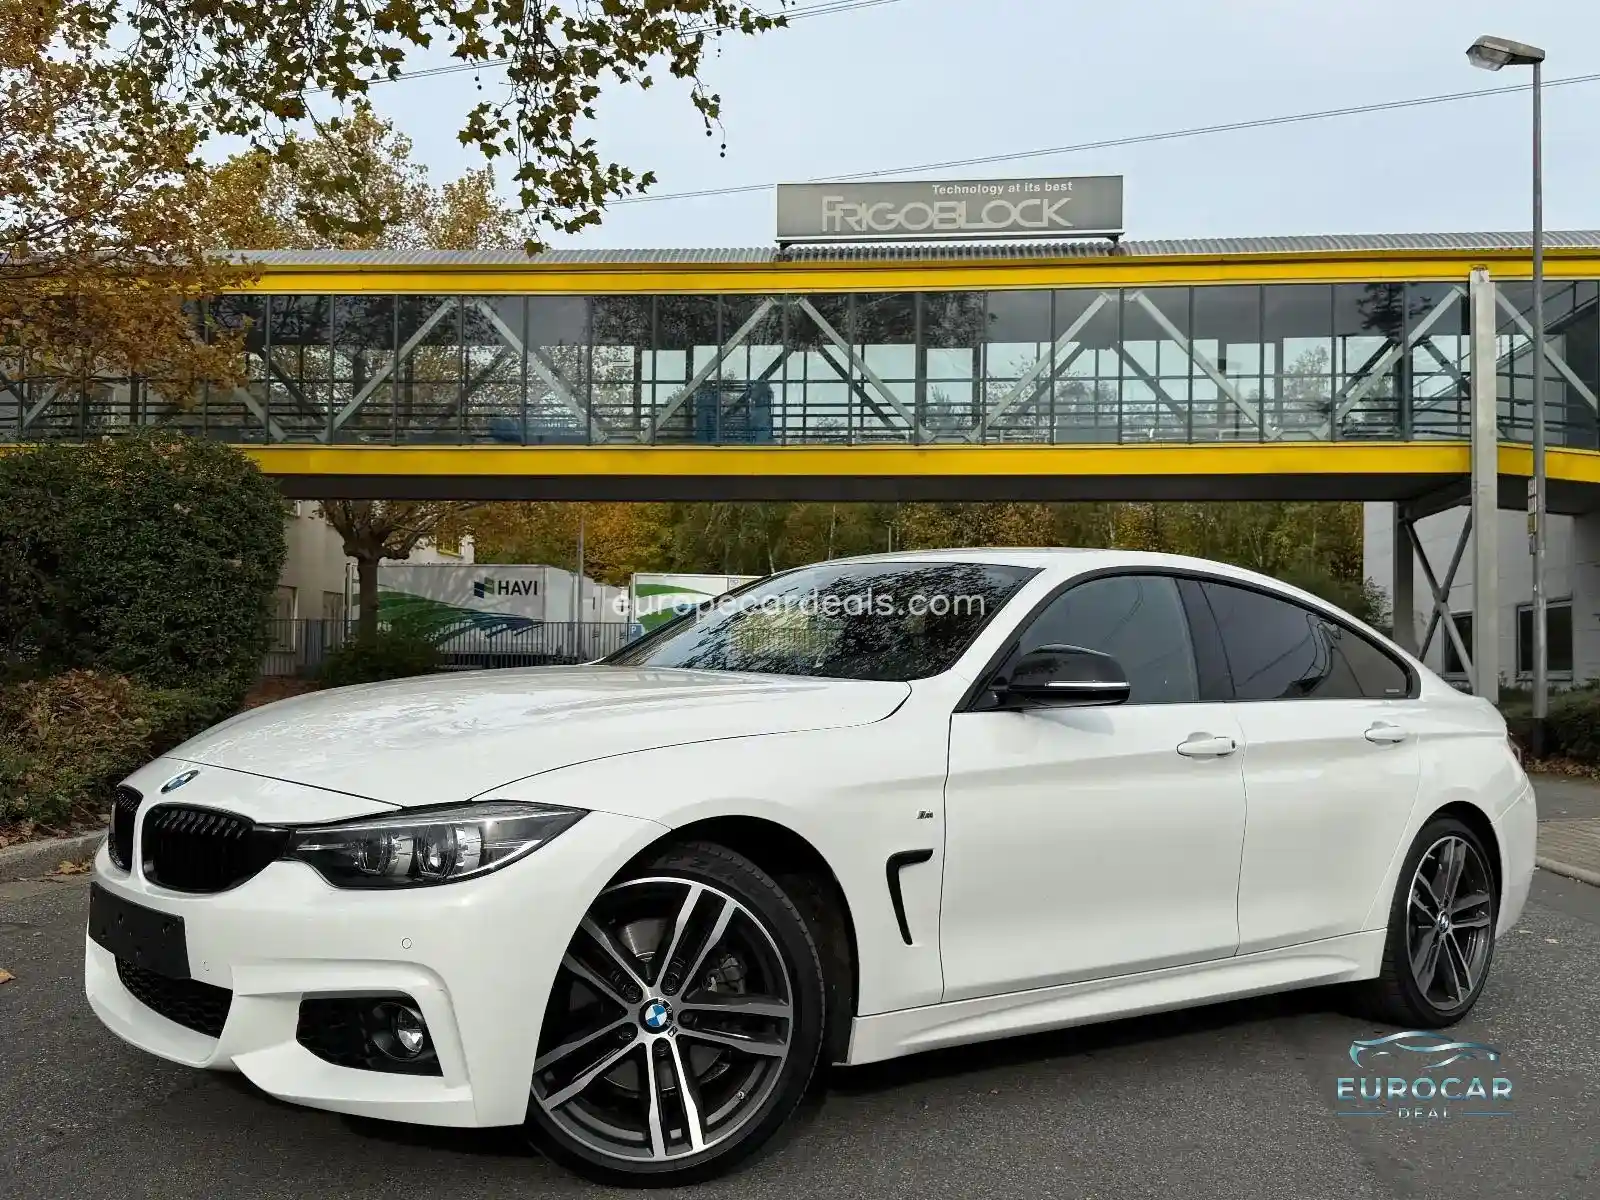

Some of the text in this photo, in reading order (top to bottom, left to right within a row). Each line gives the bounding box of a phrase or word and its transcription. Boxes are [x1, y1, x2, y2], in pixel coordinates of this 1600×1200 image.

[932, 181, 1073, 195] Technology at its best
[821, 195, 1074, 232] FRIGOBLOCK
[498, 580, 538, 596] HAVI
